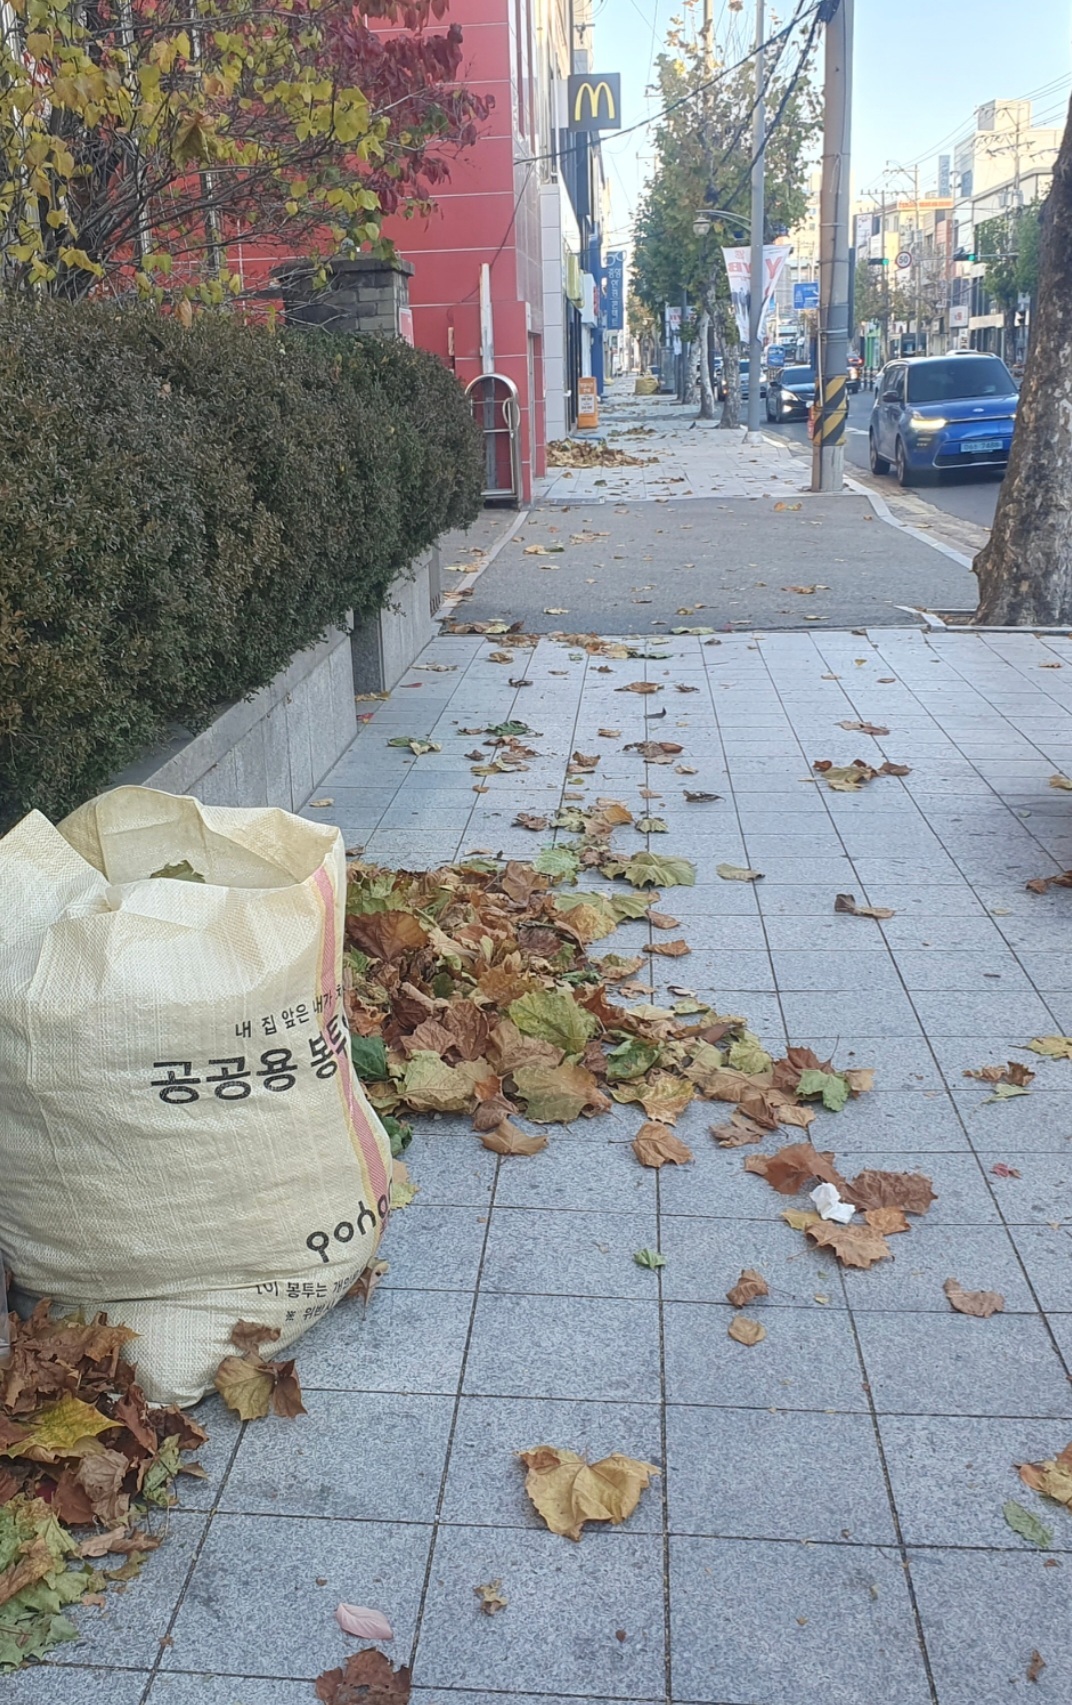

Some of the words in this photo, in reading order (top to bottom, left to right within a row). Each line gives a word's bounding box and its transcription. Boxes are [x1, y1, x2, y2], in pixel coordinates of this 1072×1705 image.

[899, 255, 909, 264] 50
[235, 1020, 252, 1038] 내
[261, 1014, 277, 1036] 집
[281, 1003, 310, 1030] 앞은
[312, 990, 333, 1014] 내가
[150, 1047, 299, 1105] 공공용
[308, 1014, 348, 1080] 봉투
[286, 1282, 328, 1299] 봉투는
